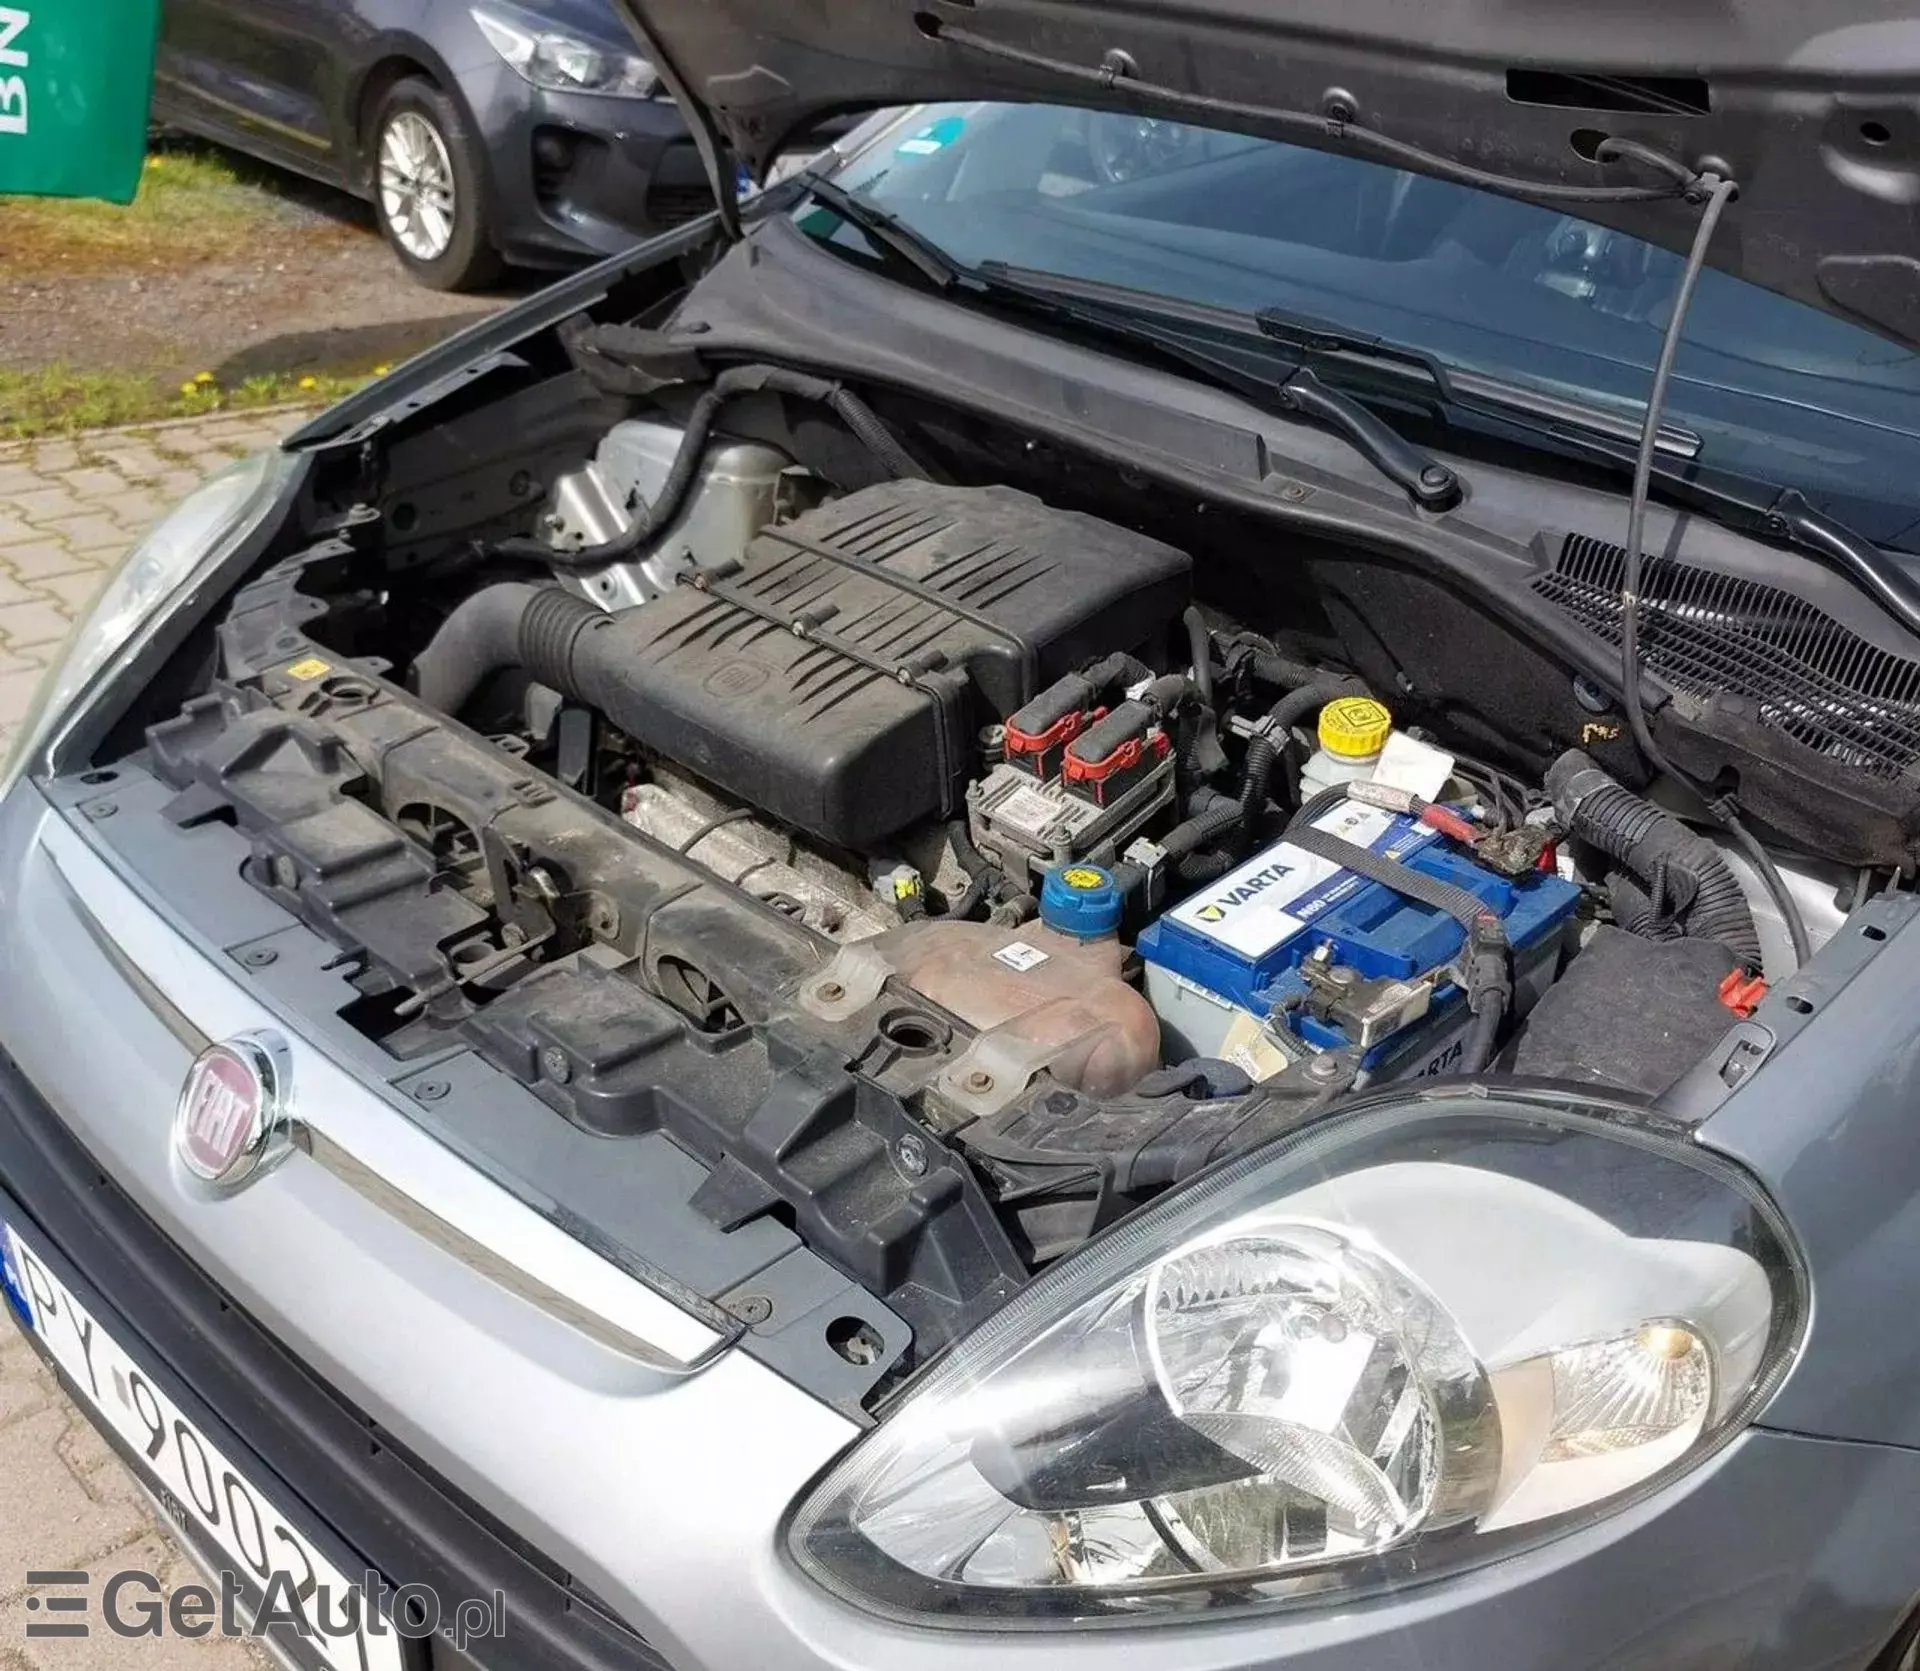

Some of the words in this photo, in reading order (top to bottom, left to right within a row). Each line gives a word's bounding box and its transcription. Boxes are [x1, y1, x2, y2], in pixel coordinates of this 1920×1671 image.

[1216, 862, 1295, 907] VARTA
[1417, 1040, 1463, 1077] RTA
[189, 1069, 250, 1158] FIAT
[20, 1246, 100, 1400] PY
